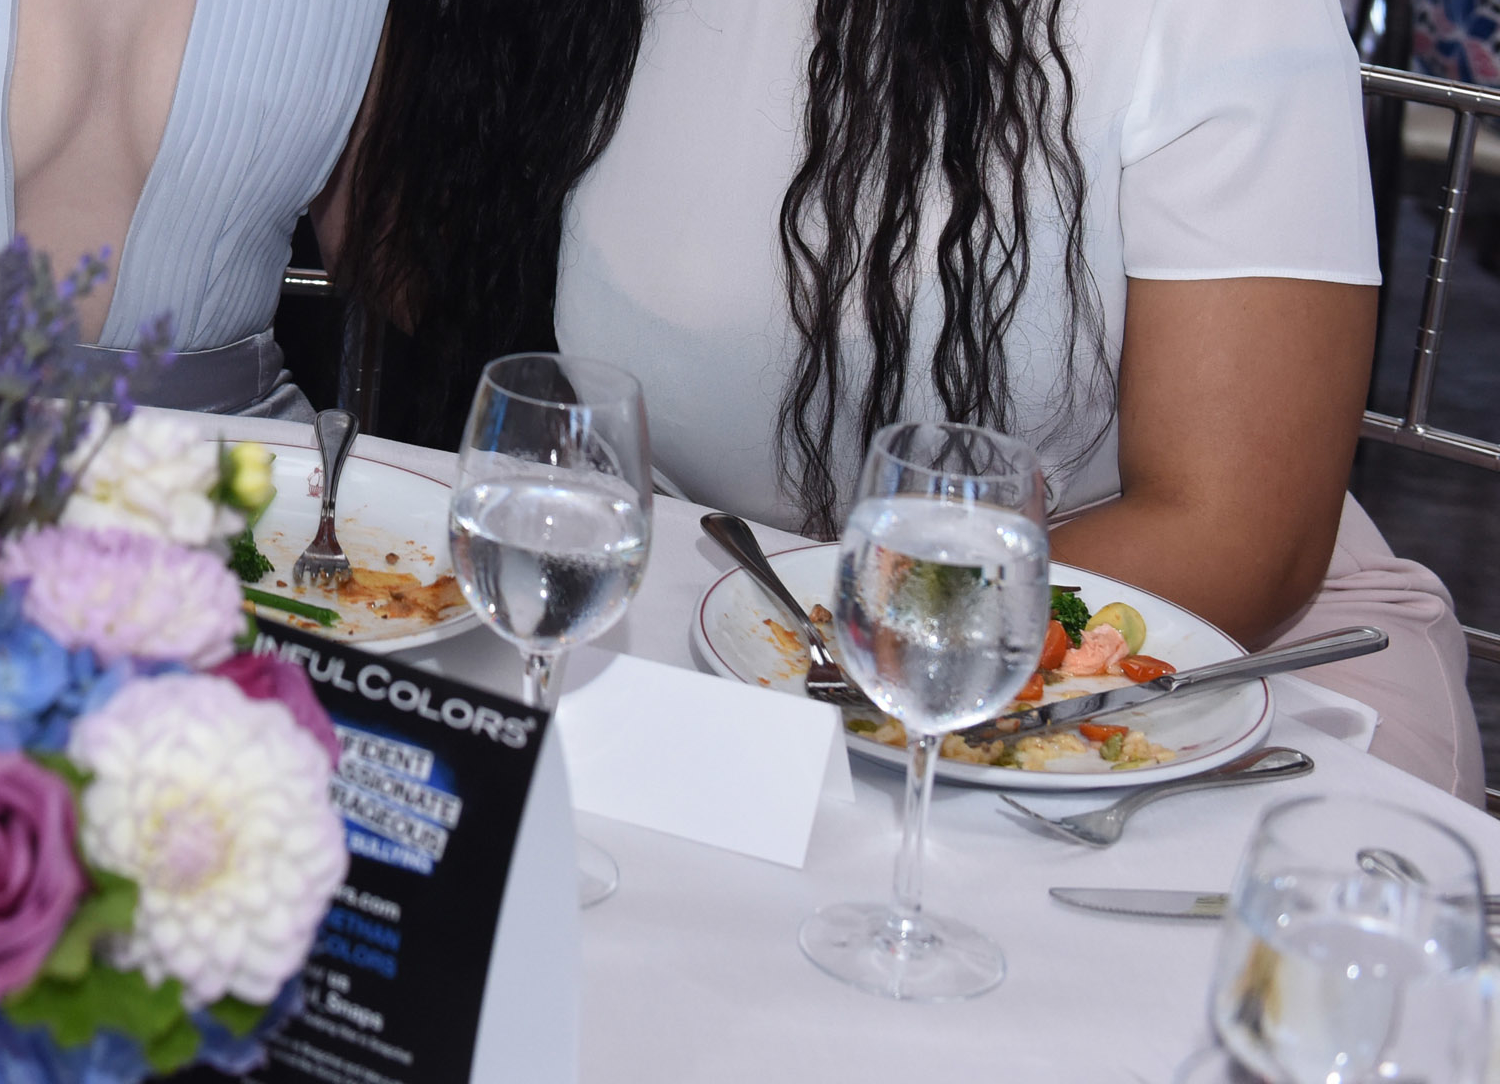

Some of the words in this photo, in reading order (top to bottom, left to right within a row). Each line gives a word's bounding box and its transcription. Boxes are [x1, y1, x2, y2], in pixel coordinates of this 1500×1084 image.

[252, 631, 533, 749] INFULCOLORS
[330, 782, 439, 853] RAGEOUS
[342, 757, 454, 822] SSIONATE
